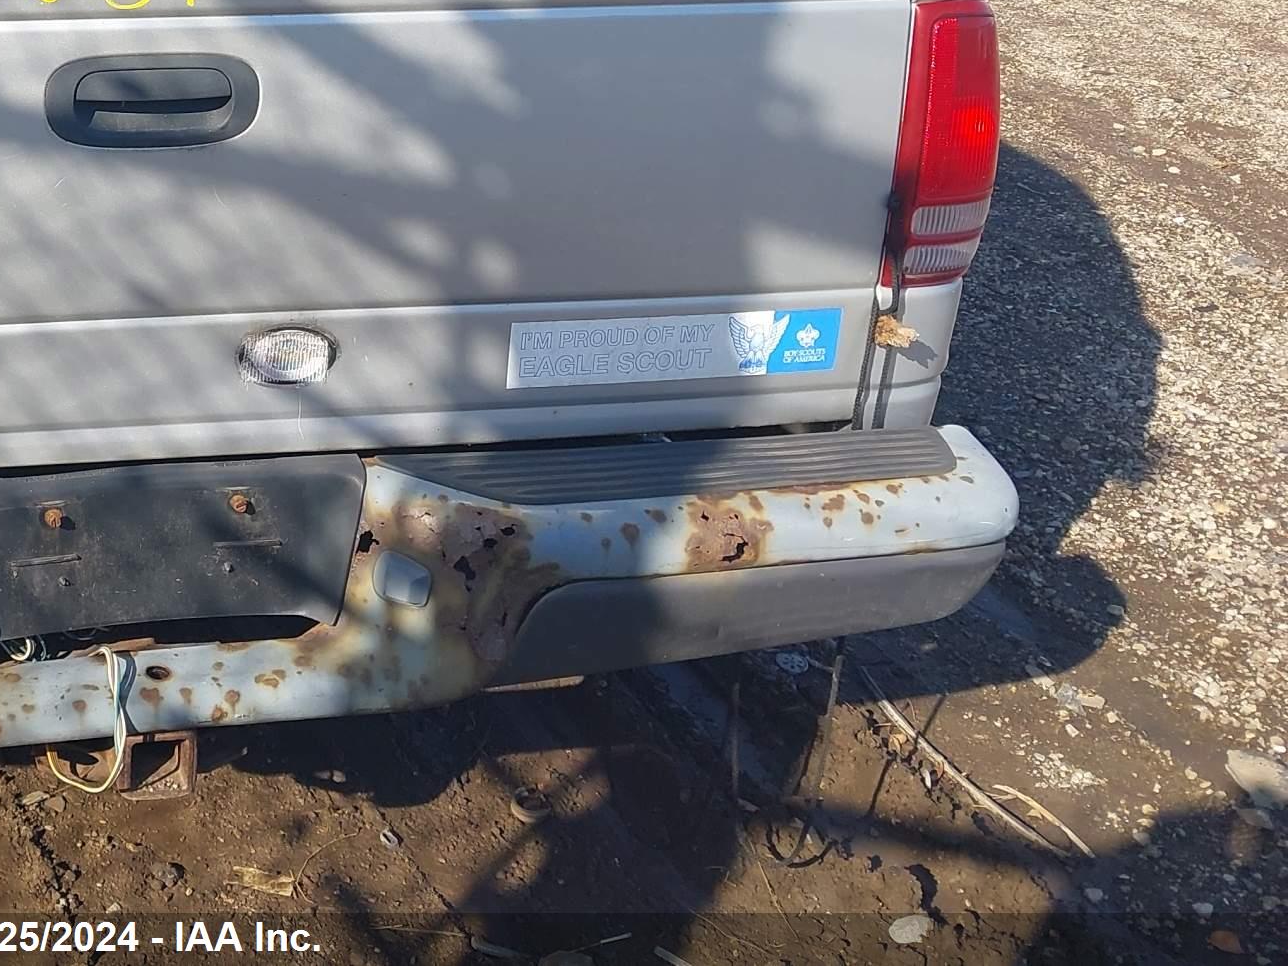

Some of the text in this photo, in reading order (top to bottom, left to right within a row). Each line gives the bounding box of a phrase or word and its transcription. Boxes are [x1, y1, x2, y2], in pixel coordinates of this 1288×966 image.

[520, 324, 715, 350] I'M PROUD OF MY
[519, 348, 712, 378] EAGLE SCOUT
